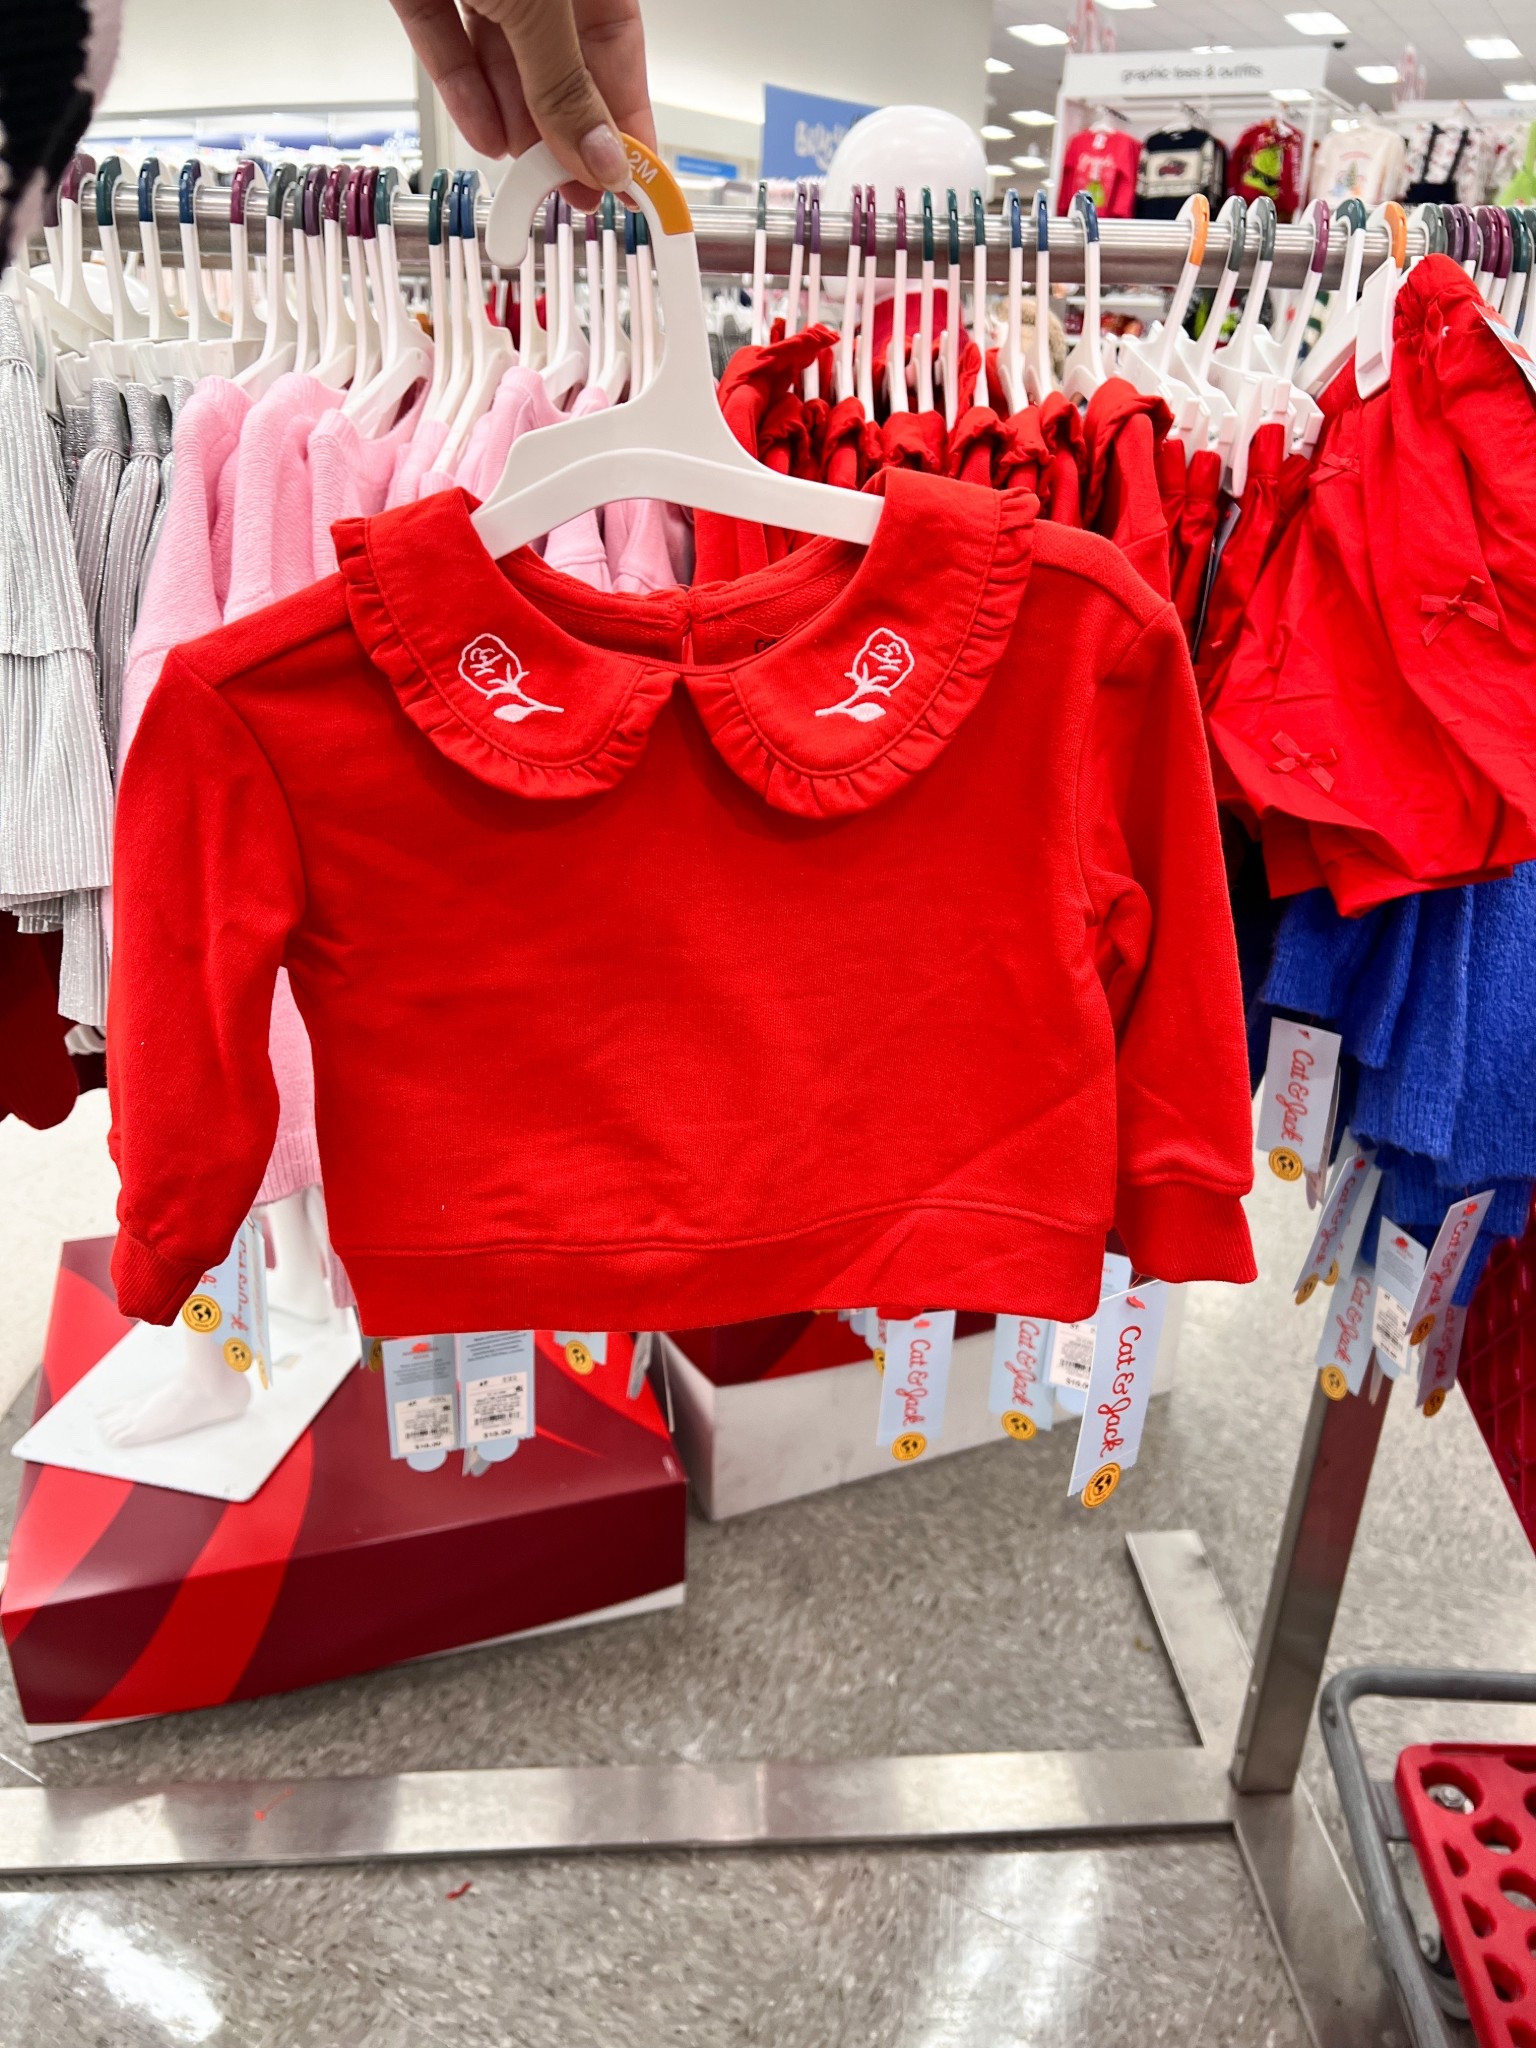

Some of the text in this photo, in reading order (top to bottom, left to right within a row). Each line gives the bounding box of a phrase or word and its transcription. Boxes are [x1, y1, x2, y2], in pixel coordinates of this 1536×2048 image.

[1275, 1049, 1315, 1146] Cat & Jack
[1350, 1276, 1371, 1309] Cat
[1004, 1320, 1040, 1407] Cat & Jack
[1116, 1325, 1142, 1371] Cat
[1335, 1313, 1359, 1366] Jack
[895, 1339, 931, 1426] Cat & Jack
[1112, 1372, 1135, 1396] &
[1097, 1396, 1132, 1458] Jack
